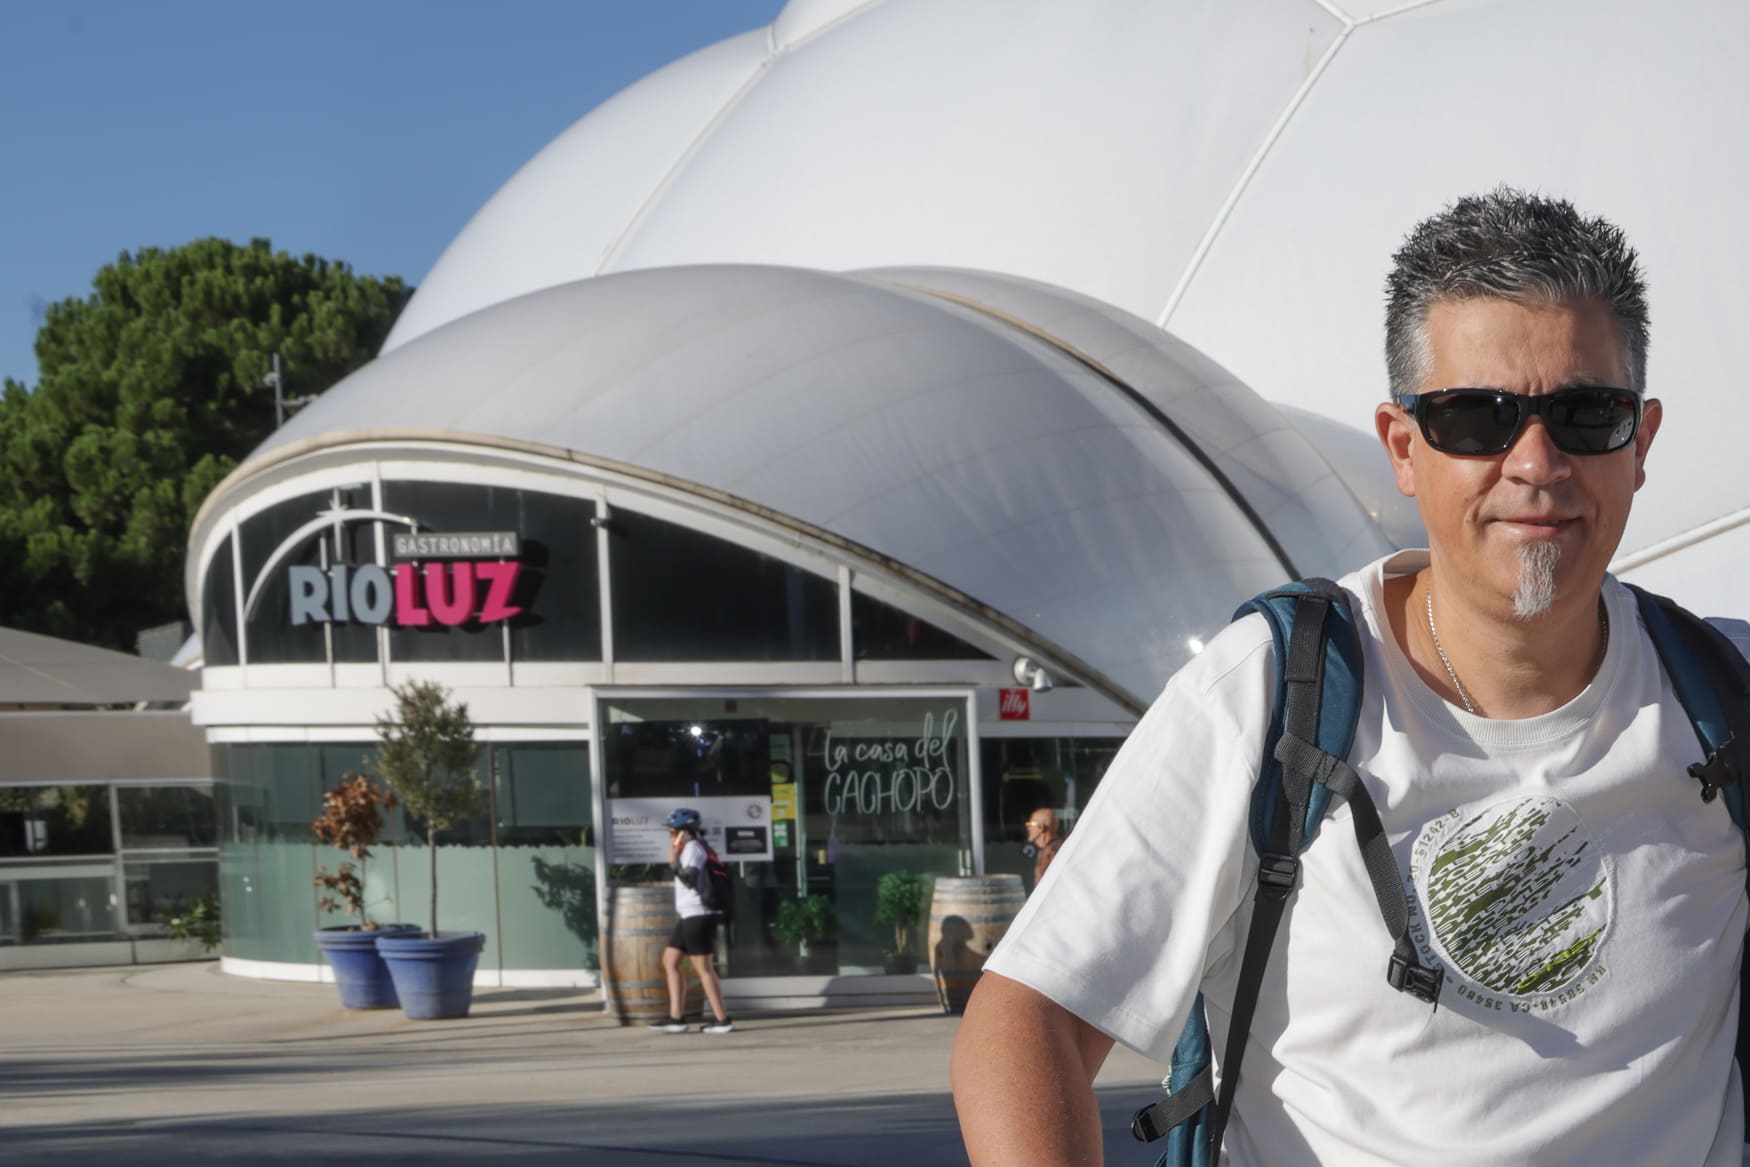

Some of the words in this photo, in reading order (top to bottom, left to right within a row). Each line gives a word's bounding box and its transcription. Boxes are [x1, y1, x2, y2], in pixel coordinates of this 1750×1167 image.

[398, 534, 513, 554] GASTRONOMÍA
[288, 560, 523, 626] RIOLUZ
[1001, 691, 1026, 716] illy
[855, 740, 909, 763] casa
[914, 708, 958, 770] del
[824, 767, 954, 815] CACHOPO
